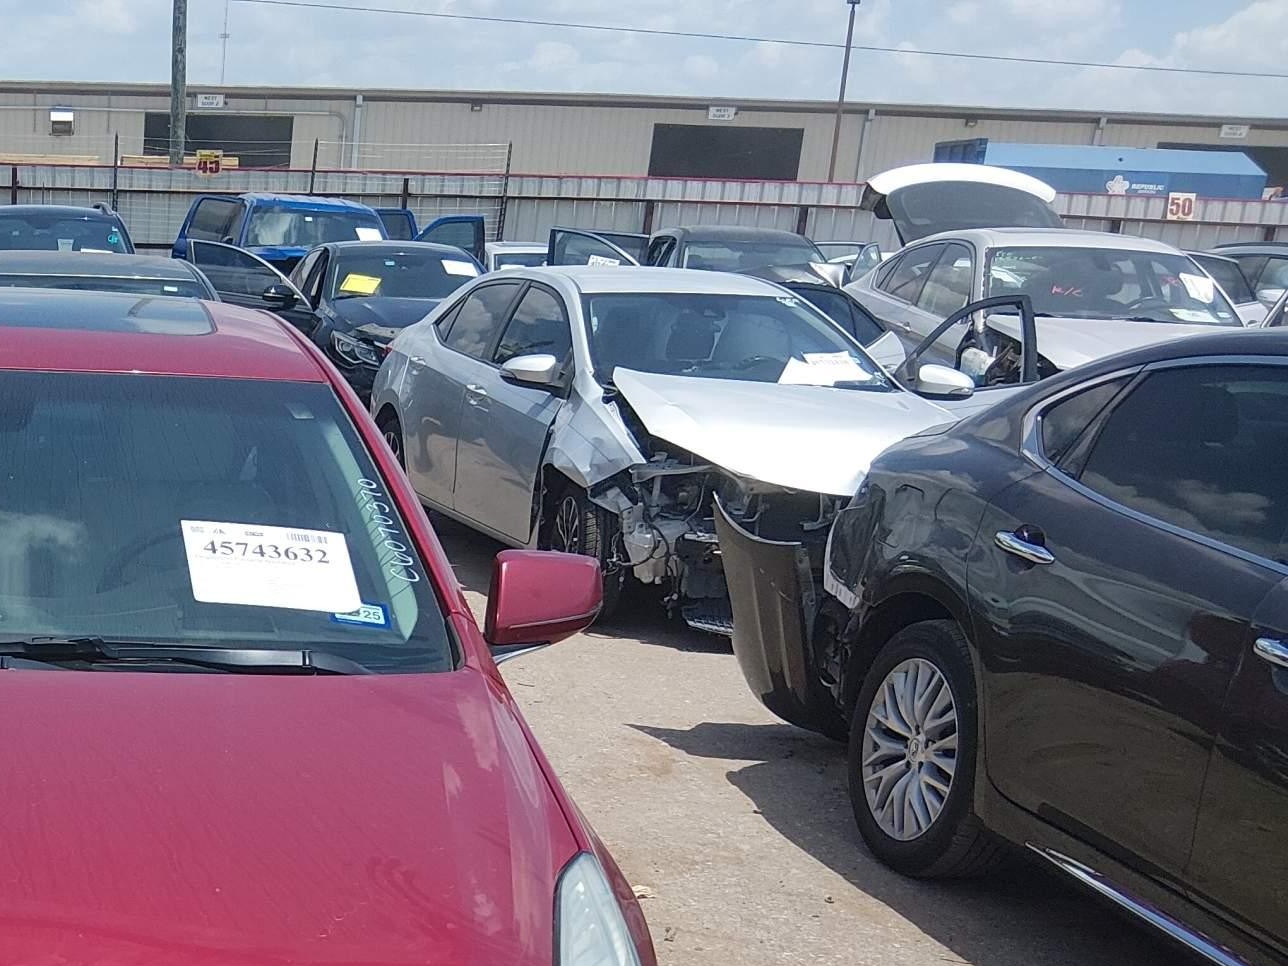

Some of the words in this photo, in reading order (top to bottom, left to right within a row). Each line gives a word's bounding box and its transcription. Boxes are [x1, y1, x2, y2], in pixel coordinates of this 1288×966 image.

[1169, 197, 1193, 217] 50
[203, 539, 330, 564] 45743632
[362, 610, 381, 620] 25
